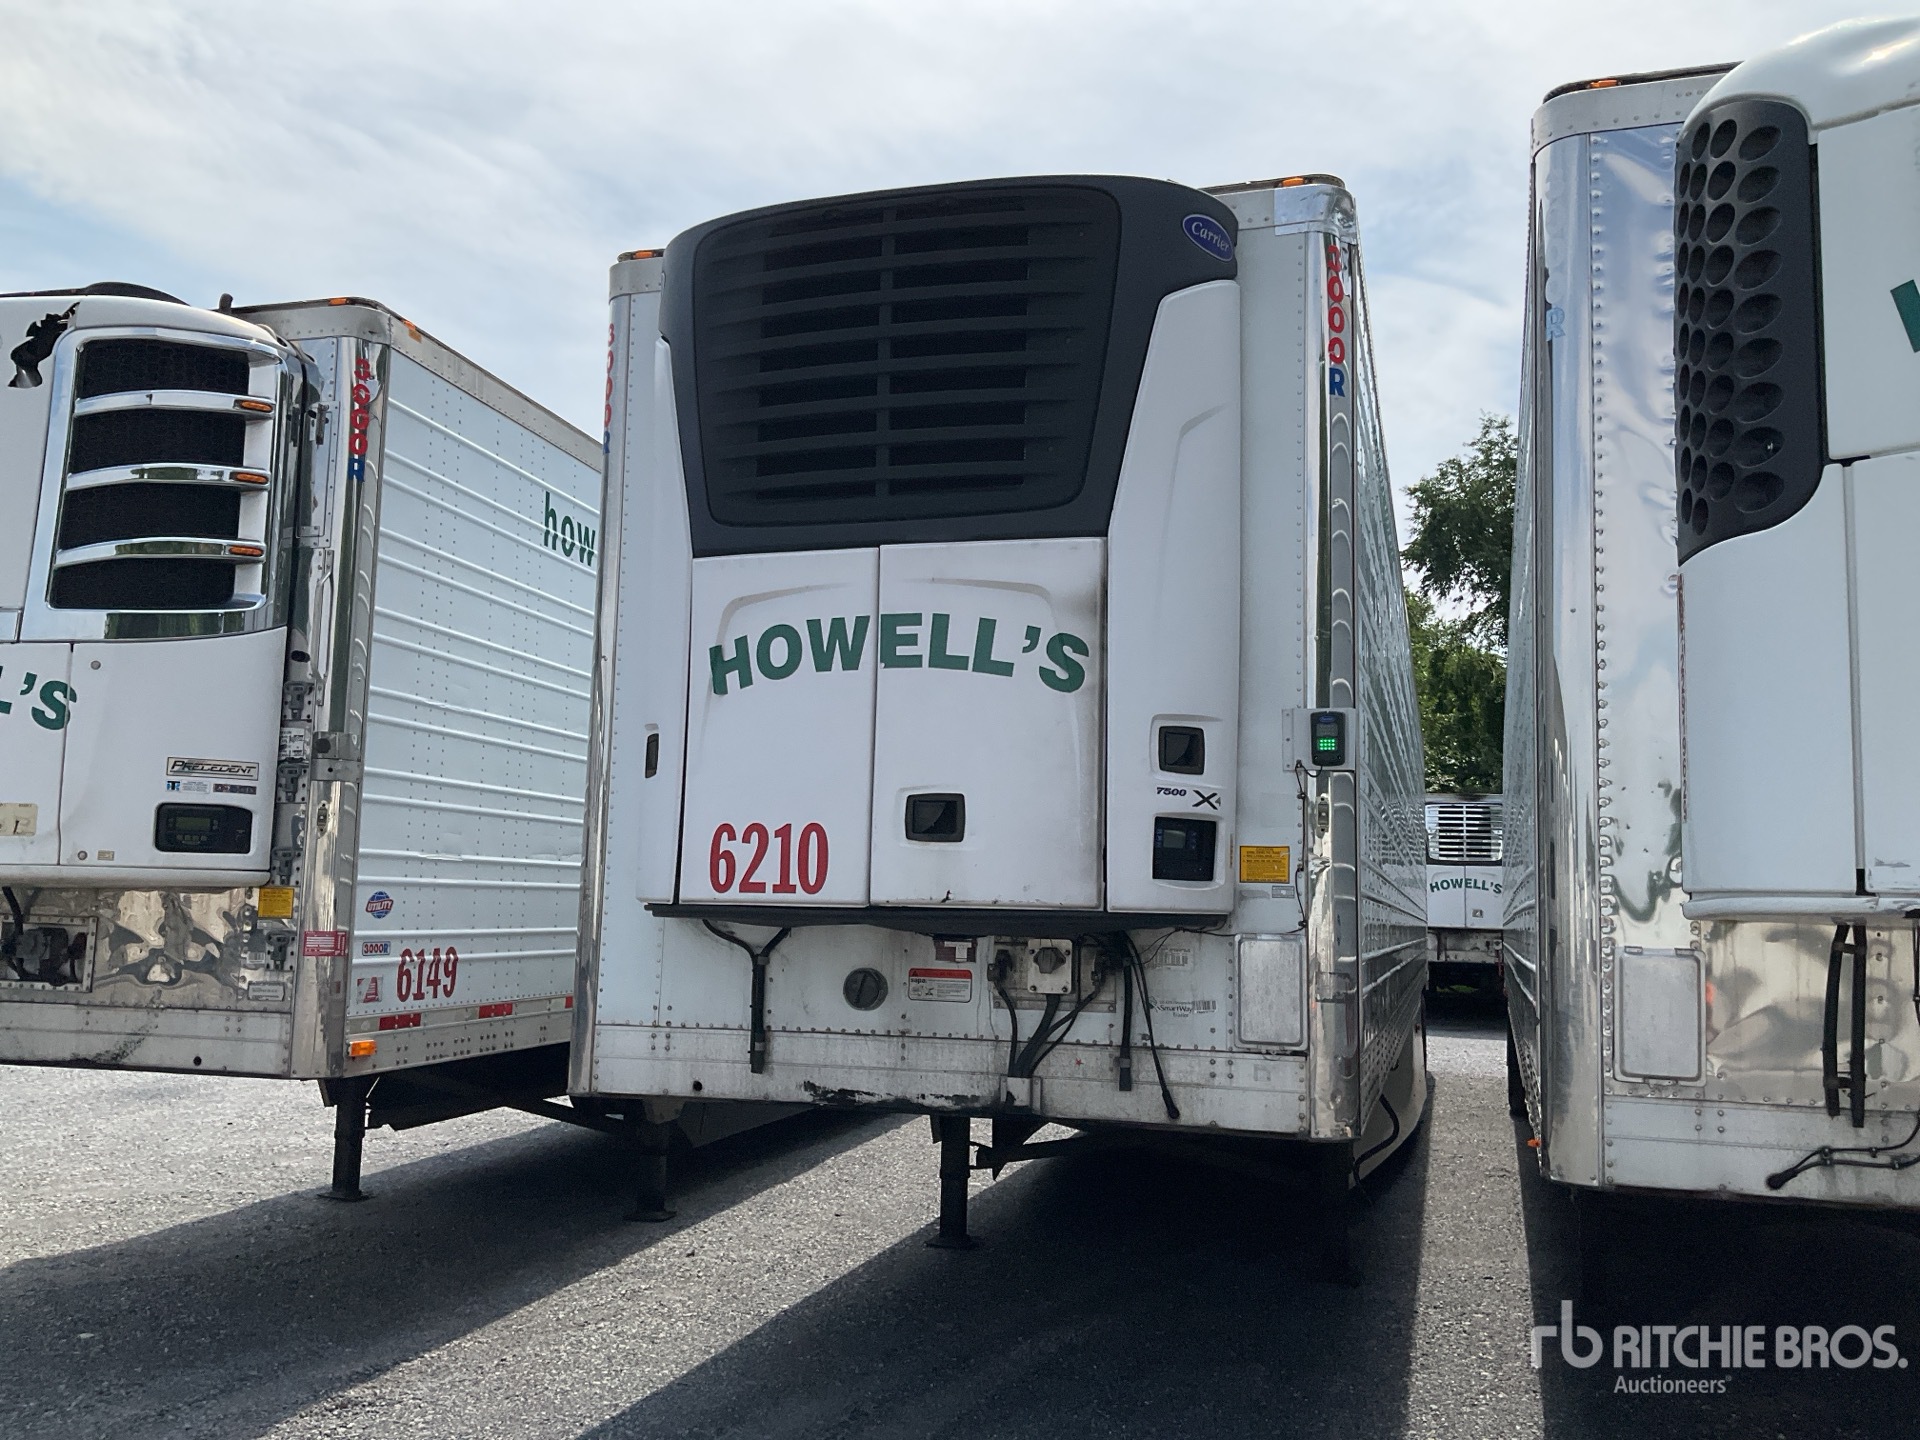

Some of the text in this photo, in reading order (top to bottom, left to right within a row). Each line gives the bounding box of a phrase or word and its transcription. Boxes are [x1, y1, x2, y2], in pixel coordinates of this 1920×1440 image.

[1191, 221, 1230, 252] Carrier
[543, 490, 596, 567] how
[709, 613, 1090, 695] HOWELL'S
[171, 760, 257, 775] PRECEDENT
[1156, 787, 1187, 797] 7500
[709, 822, 829, 894] 6210
[1429, 878, 1503, 895] HOWELL'S
[367, 901, 391, 911] UTILITY
[364, 943, 389, 954] 3000R
[397, 946, 459, 1002] 6149
